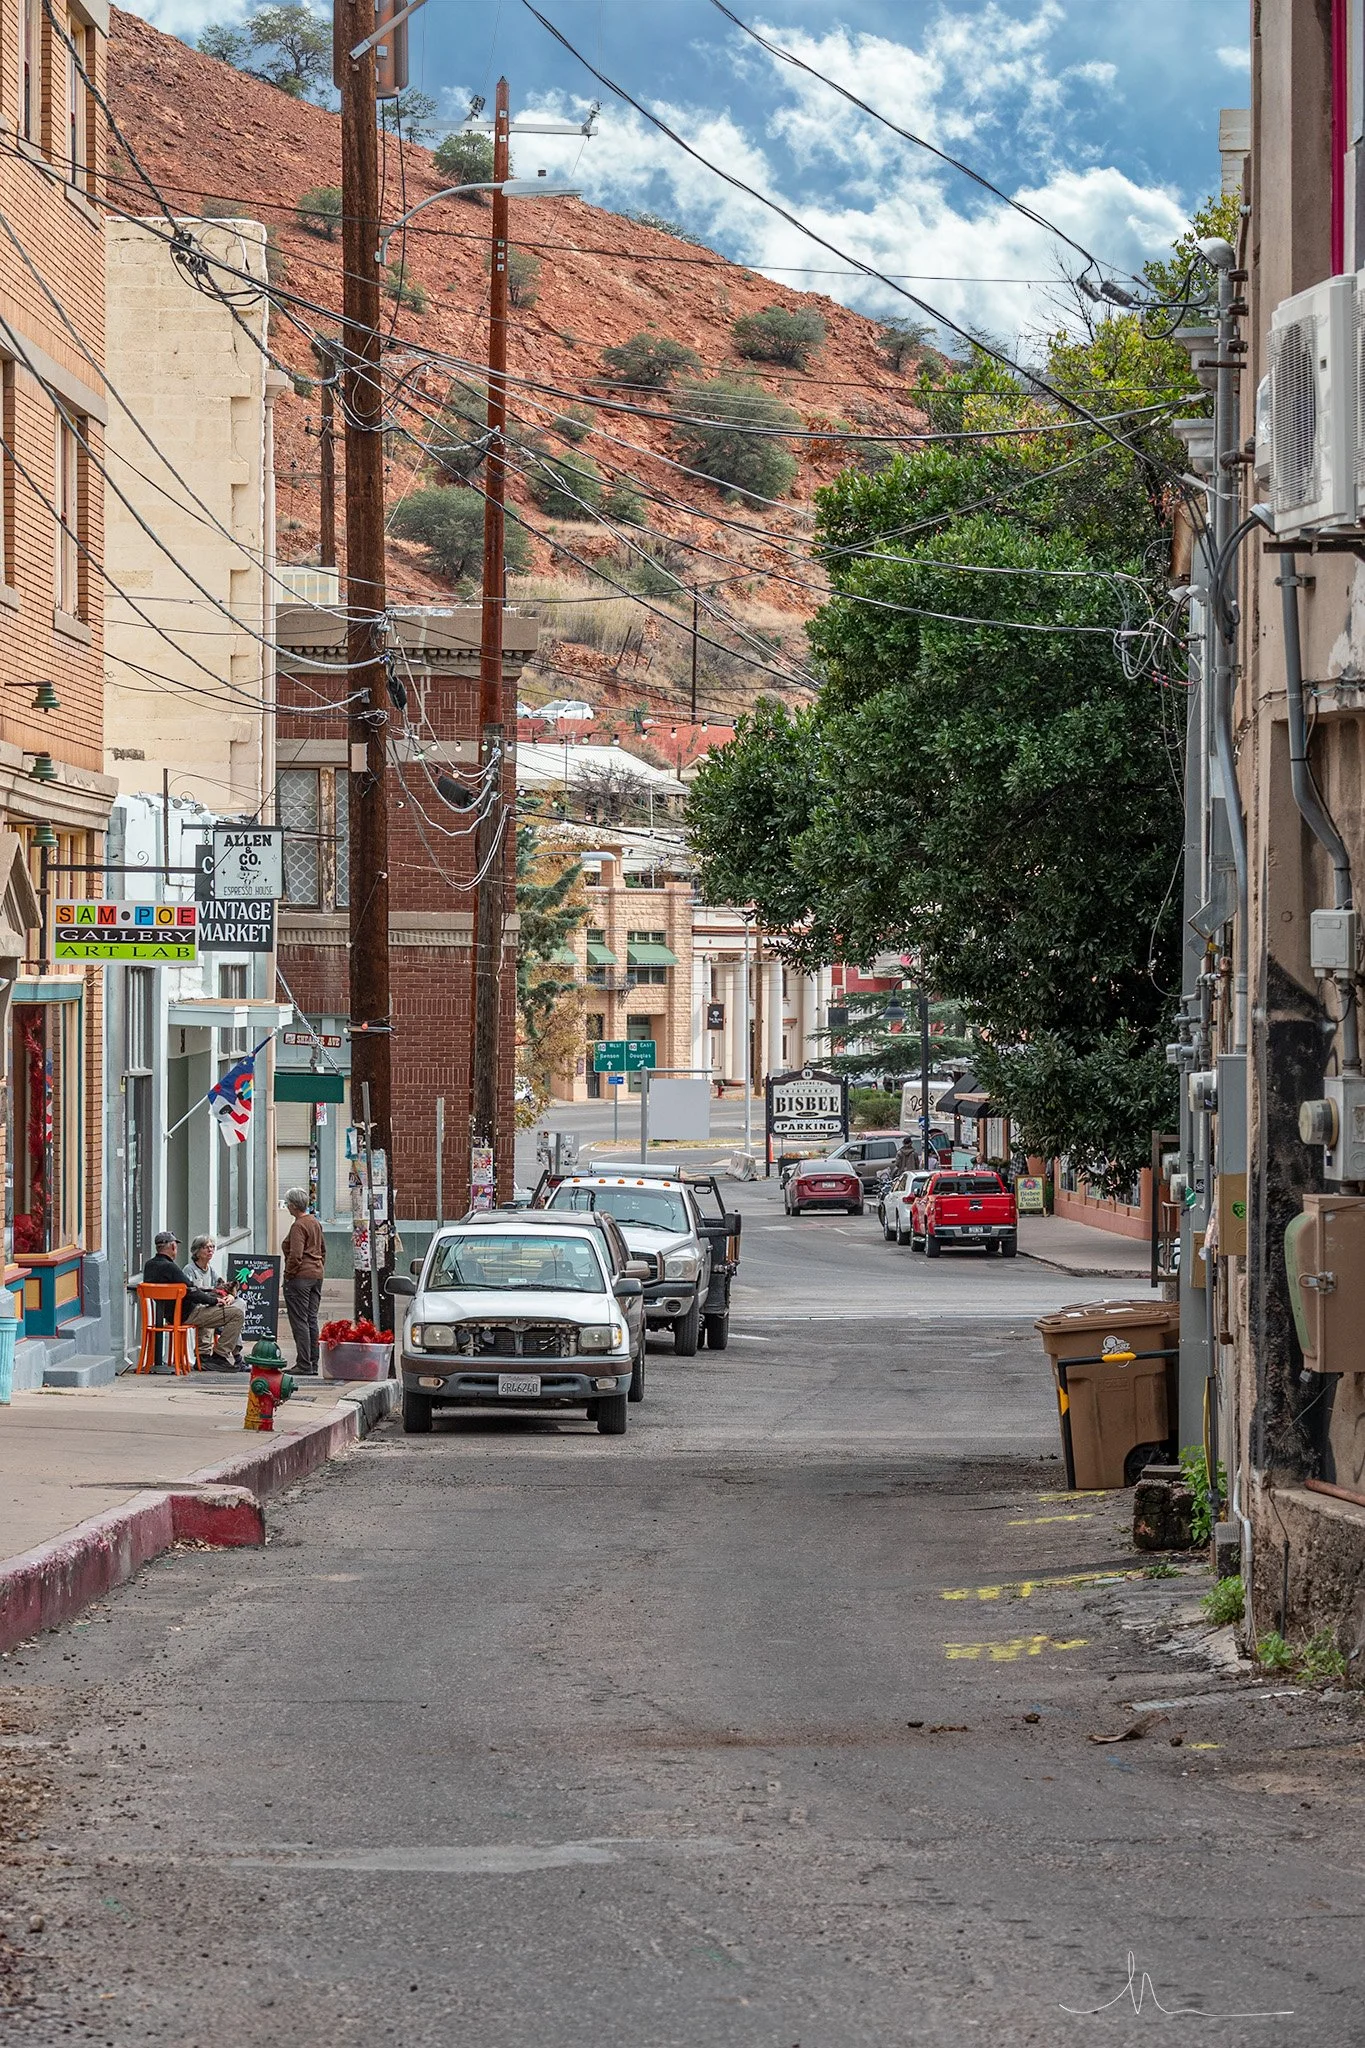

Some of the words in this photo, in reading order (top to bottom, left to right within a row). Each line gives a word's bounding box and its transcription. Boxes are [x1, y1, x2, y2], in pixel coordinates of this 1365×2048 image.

[224, 834, 272, 847] ALLEN
[245, 846, 252, 854] &
[239, 853, 262, 866] CO.
[223, 886, 253, 896] ESPRESSO
[255, 886, 273, 896] HOUSE
[199, 901, 272, 921] VINTAGE
[60, 929, 193, 942] GALLERY
[198, 923, 271, 942] MARKET
[60, 945, 119, 957] ART
[133, 946, 191, 957] LAB
[776, 1097, 839, 1113] BISBEE
